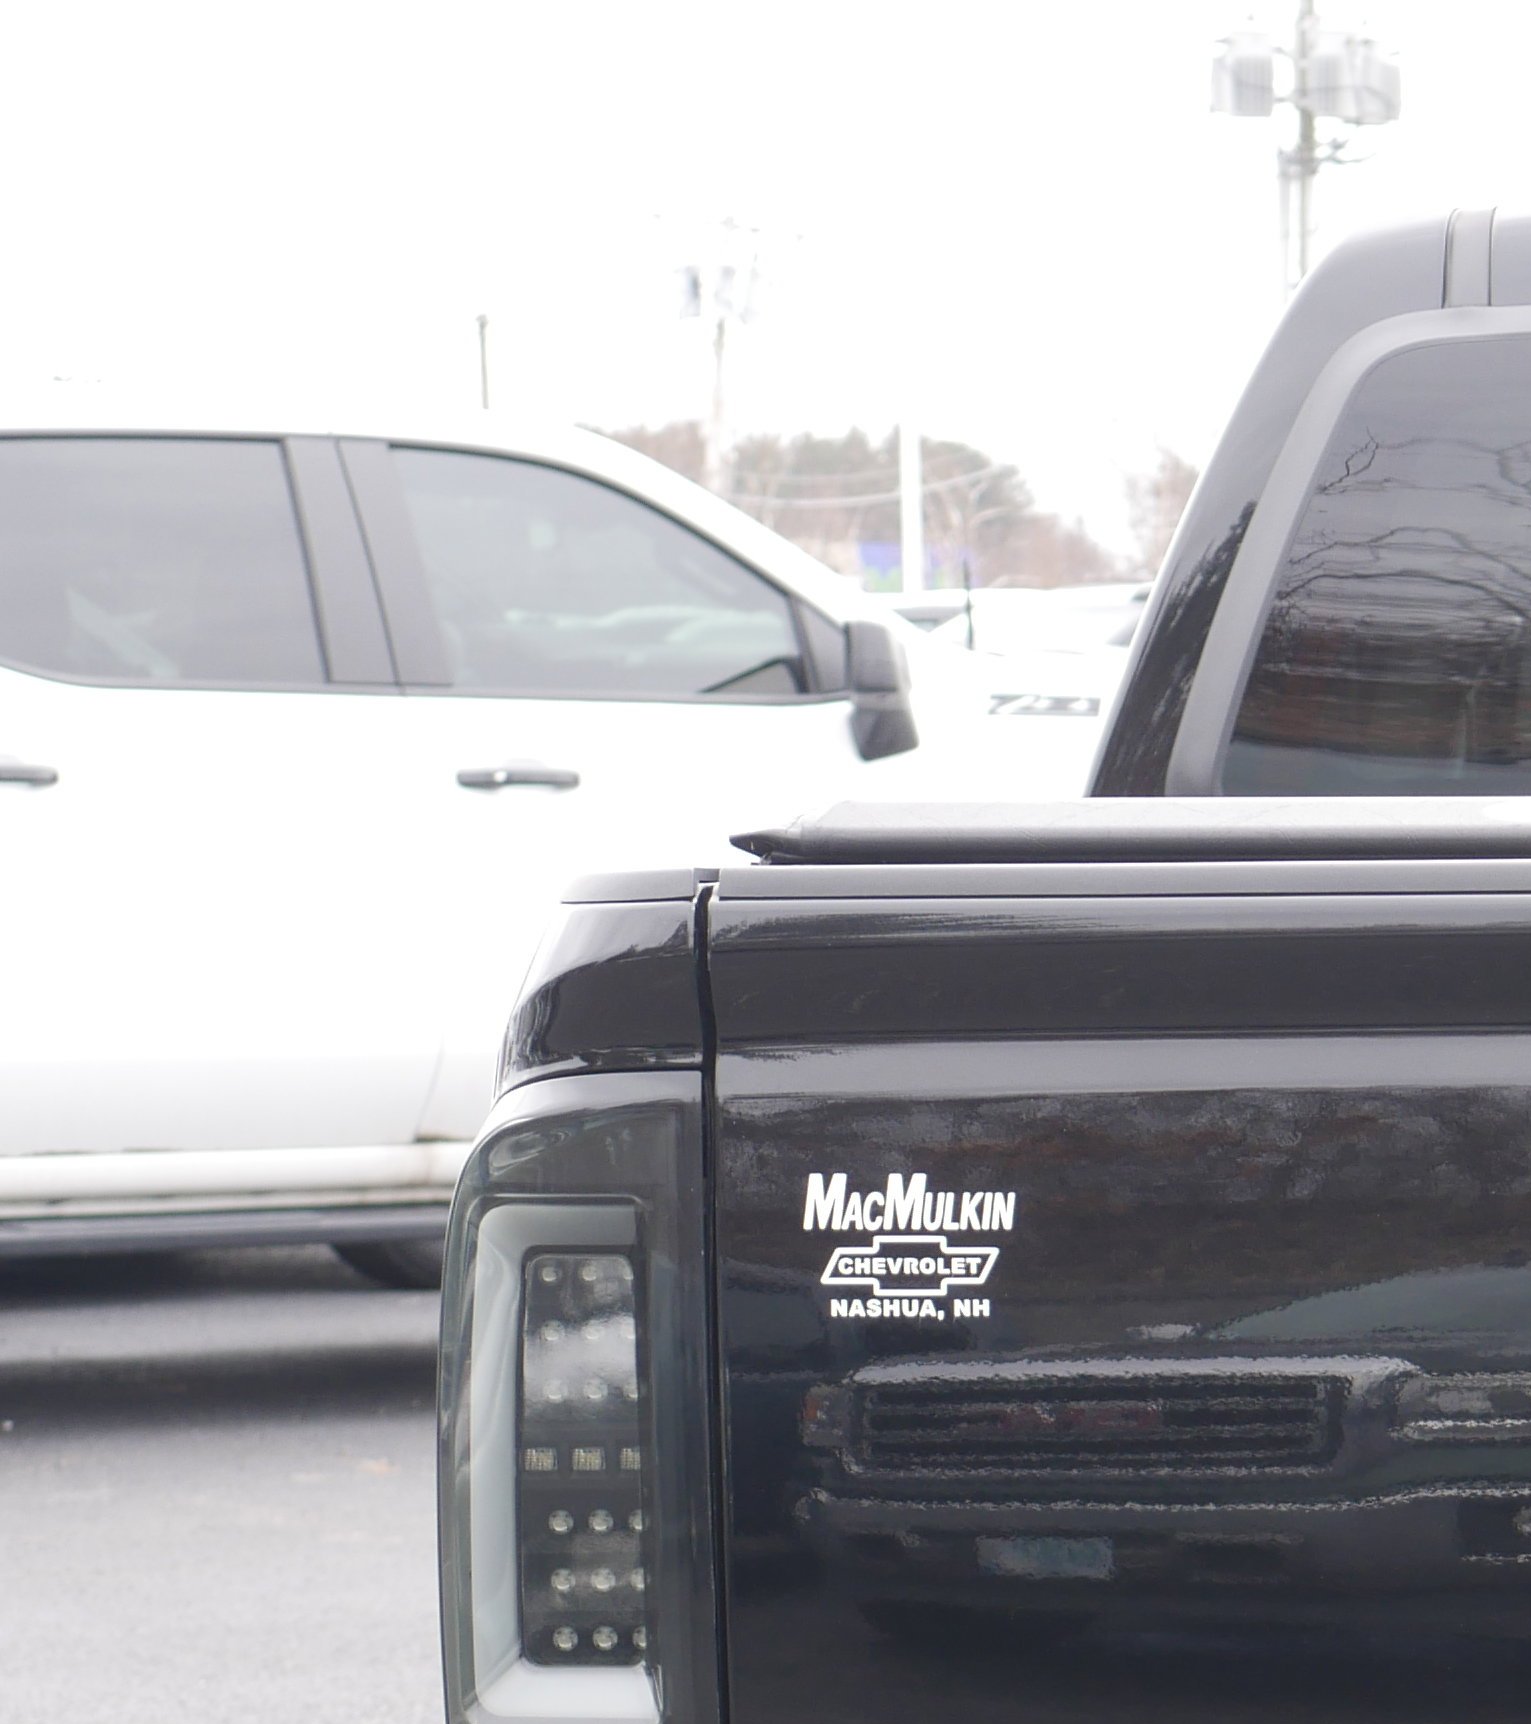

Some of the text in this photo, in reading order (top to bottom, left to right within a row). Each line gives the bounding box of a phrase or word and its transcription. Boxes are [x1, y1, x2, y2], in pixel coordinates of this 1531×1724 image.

[837, 1256, 982, 1275] CHEVROLET
[830, 1298, 991, 1321] NASHUA, NH
